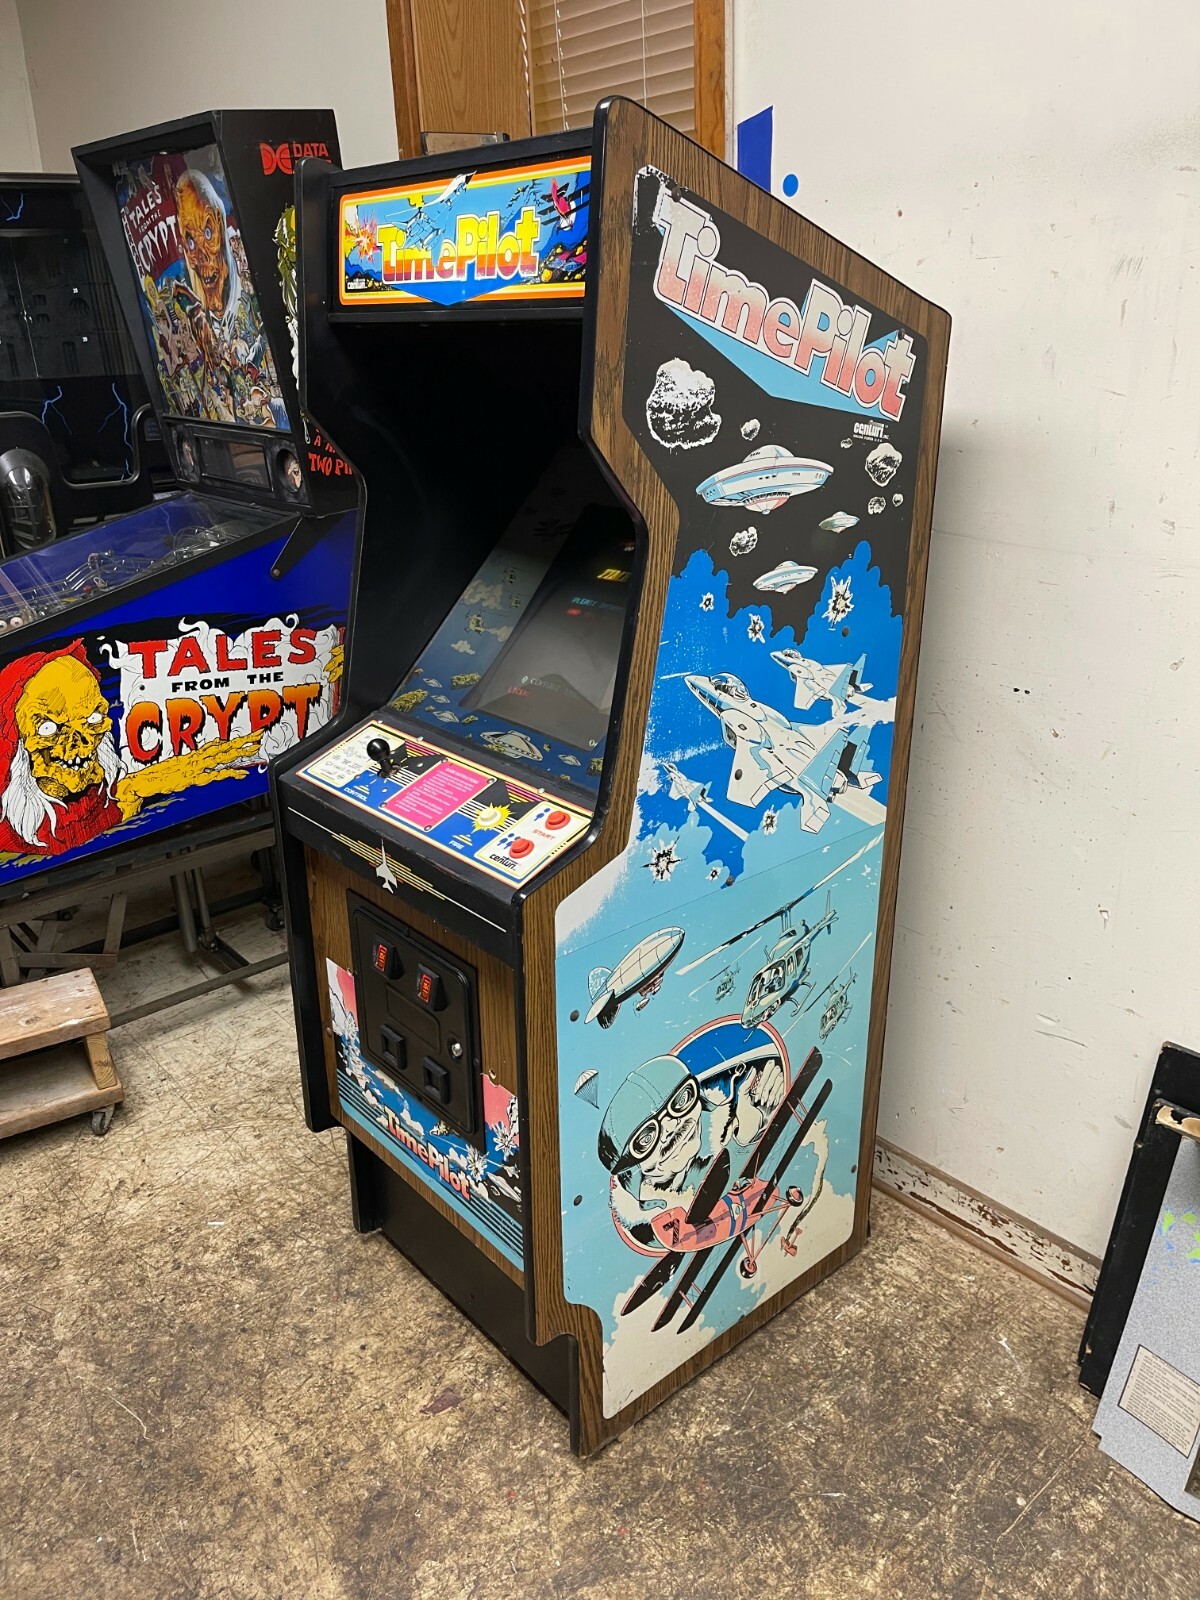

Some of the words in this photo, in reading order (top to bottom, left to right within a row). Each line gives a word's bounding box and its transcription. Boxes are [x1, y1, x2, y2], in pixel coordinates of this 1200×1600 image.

[293, 143, 329, 157] DATA
[129, 184, 162, 229] TALES
[138, 215, 178, 273] CRYPT
[853, 420, 885, 439] centuri
[308, 452, 333, 477] TWO
[128, 628, 317, 679] TALES
[172, 677, 230, 692] FROM
[246, 671, 284, 685] THE
[126, 682, 323, 766] CRYPT
[343, 786, 368, 802] CONTROL
[532, 828, 557, 840] START
[448, 840, 466, 850] FIRE
